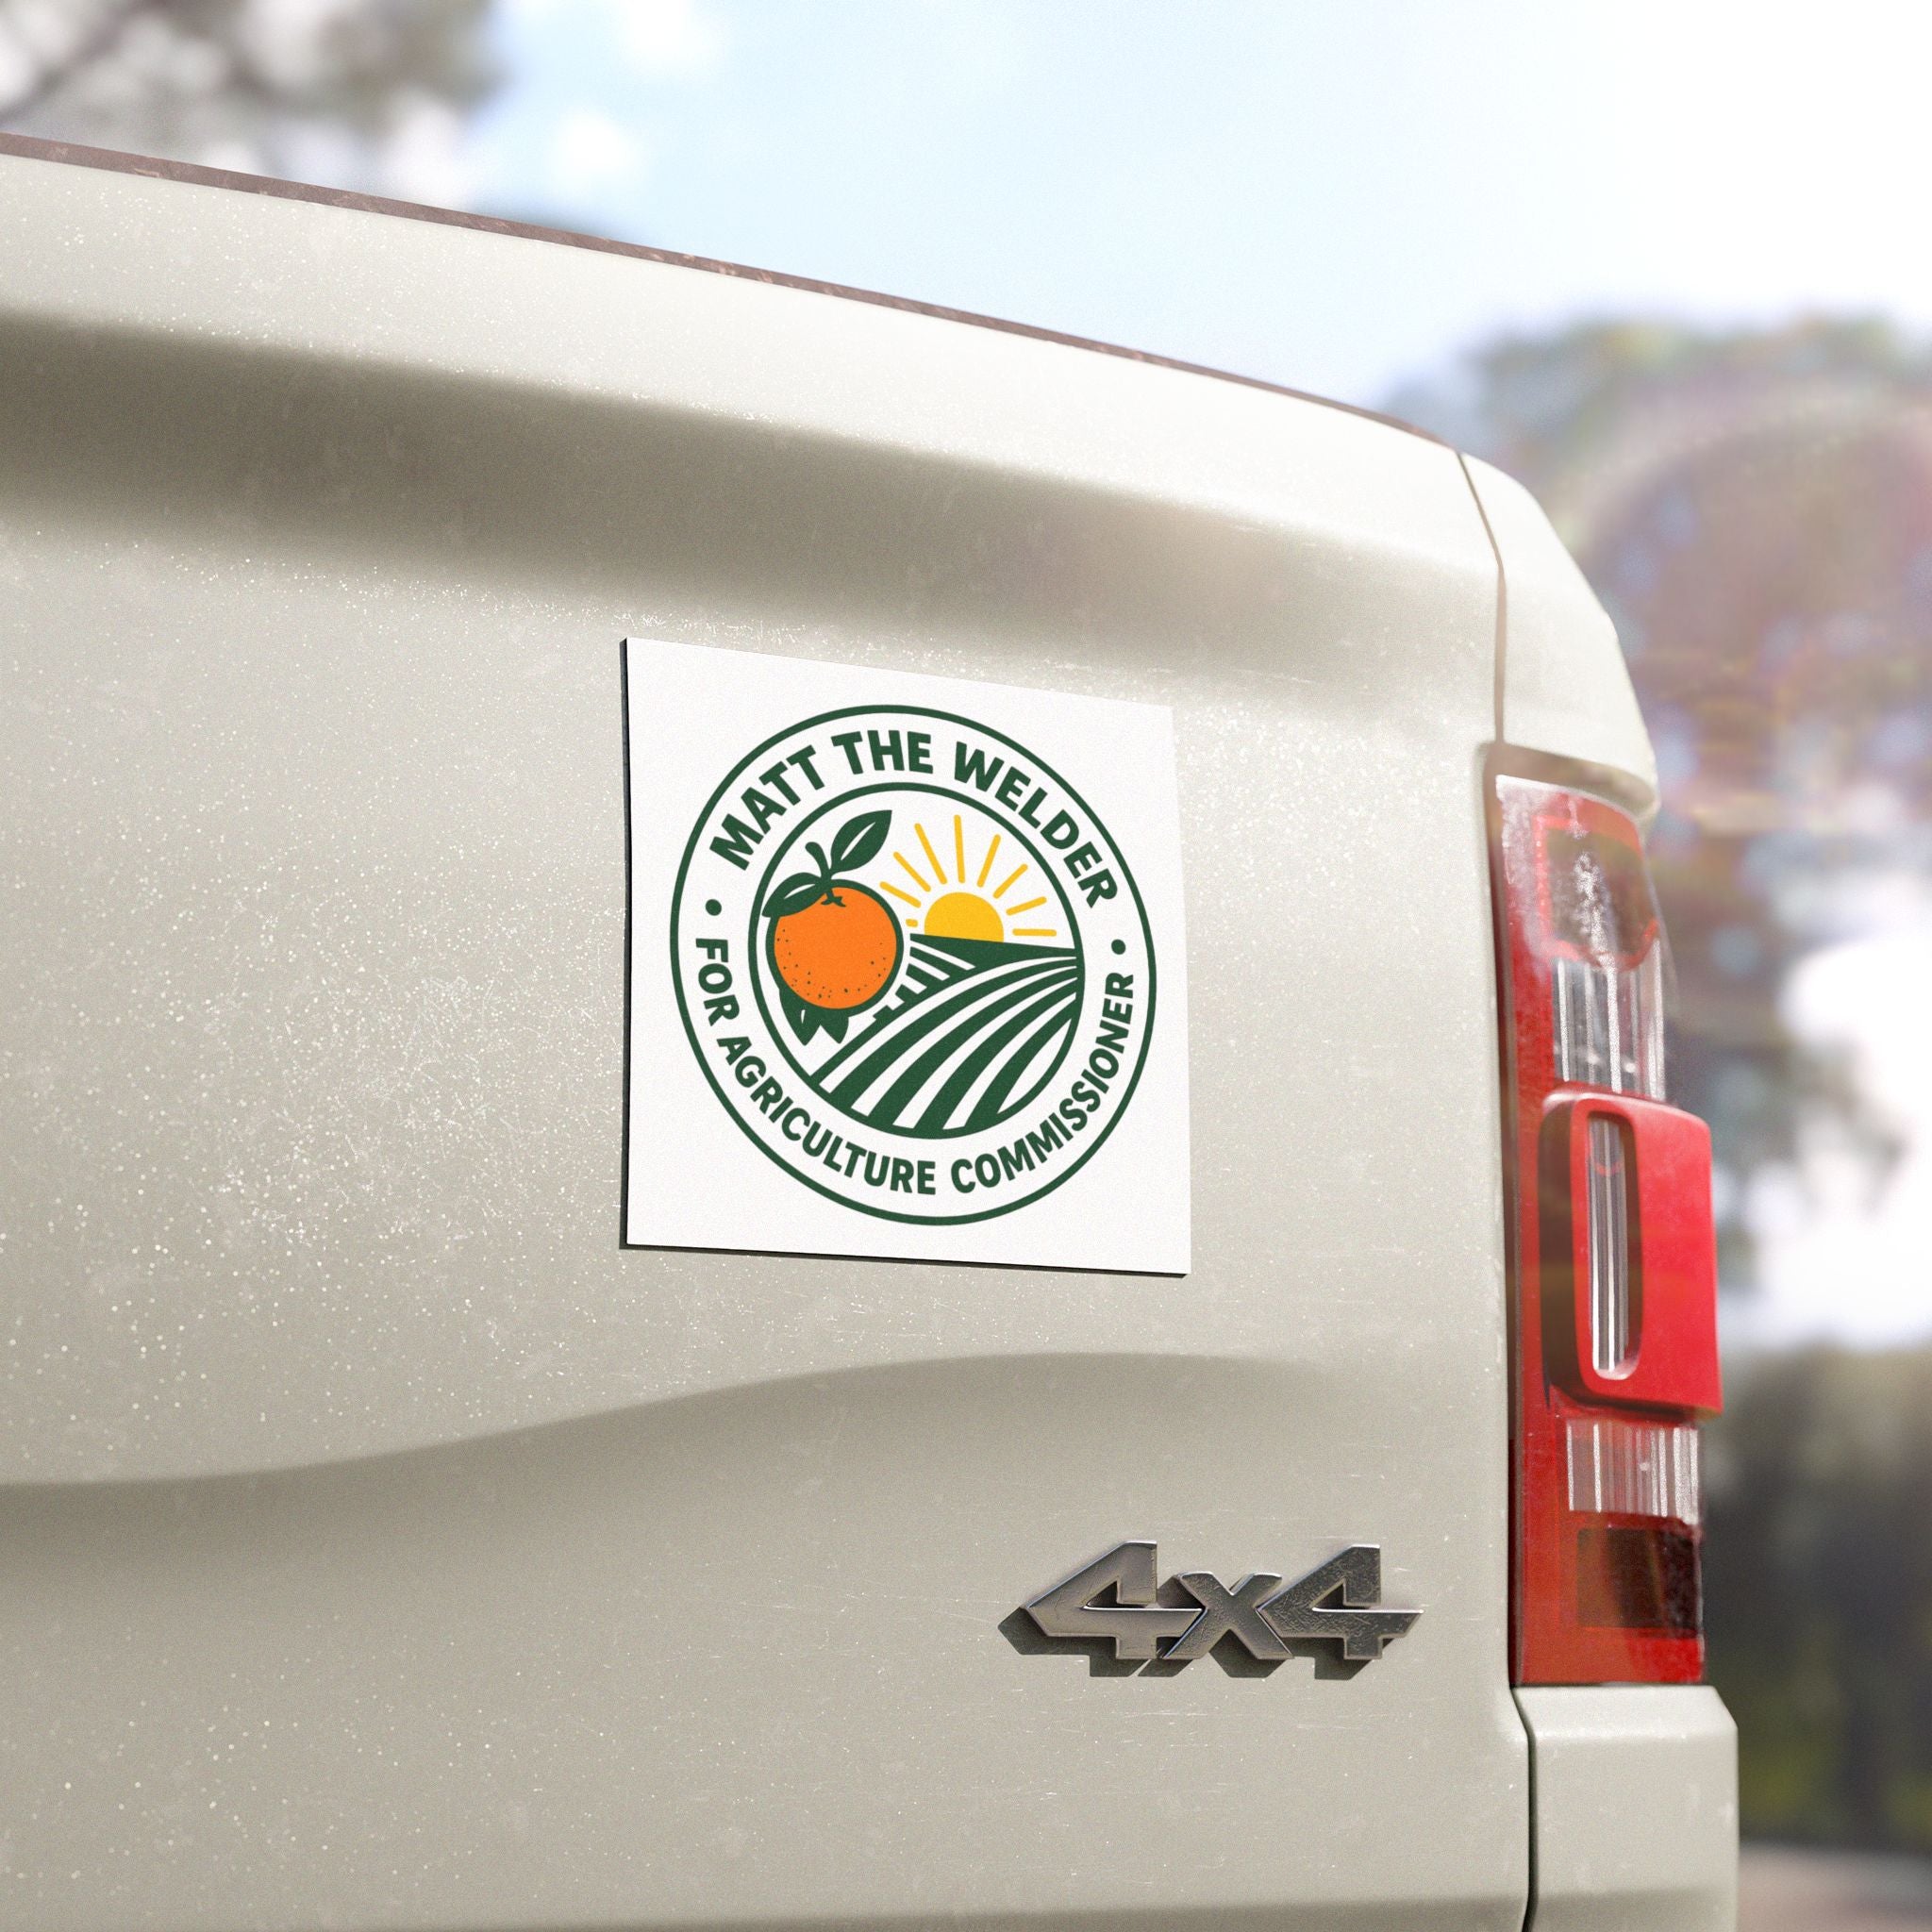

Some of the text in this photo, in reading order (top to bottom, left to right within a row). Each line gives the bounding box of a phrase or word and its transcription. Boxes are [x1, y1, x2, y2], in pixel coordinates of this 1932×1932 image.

[708, 729, 1118, 908] MATT THE WELDER
[695, 938, 1134, 1195] FOR AGRICULTURE COMMISSIONER
[1021, 1540, 1424, 1660] 4x4
